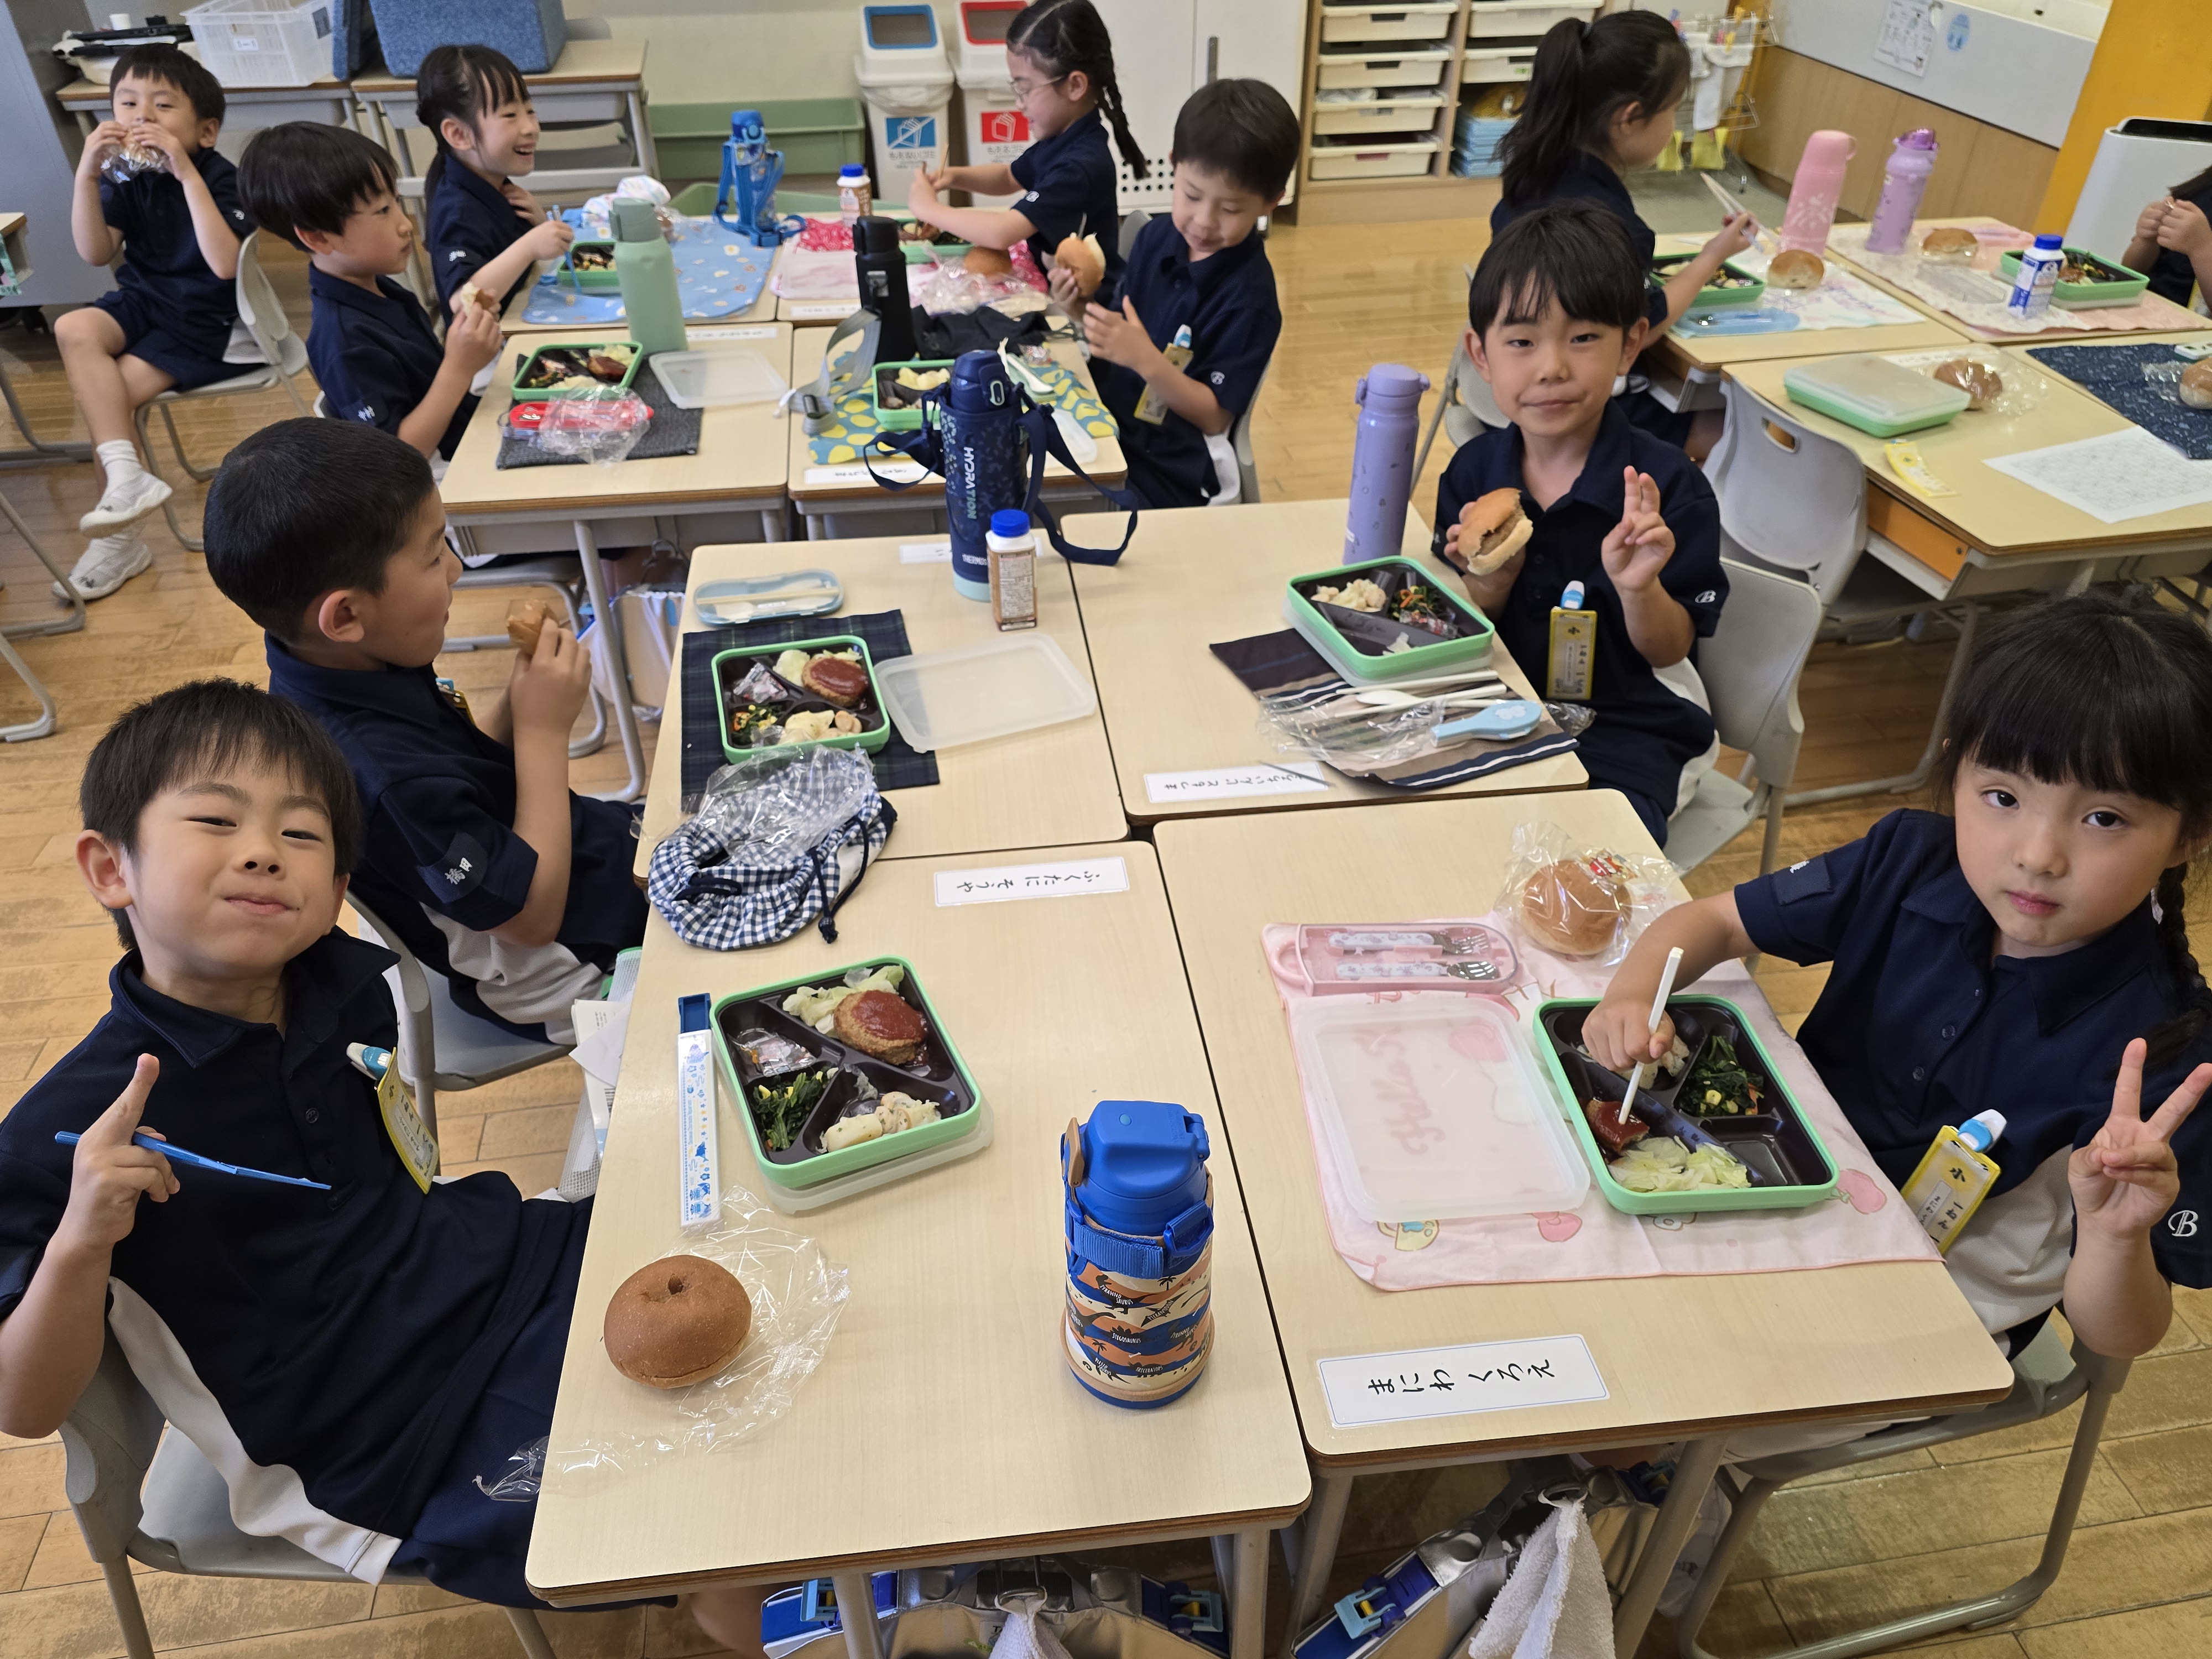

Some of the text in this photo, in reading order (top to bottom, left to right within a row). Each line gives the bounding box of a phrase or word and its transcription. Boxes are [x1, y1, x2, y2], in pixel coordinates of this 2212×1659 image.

[963, 446, 977, 519] HYDRATION
[957, 871, 1100, 893] ふくたに そうや
[1949, 1167, 1966, 1182] 小
[2168, 1210, 2199, 1237] B
[1099, 1284, 1122, 1298] TYRANNO
[1112, 1333, 1141, 1343] STEGOSAURUS
[1368, 1359, 1556, 1395] まにわ くろえ
